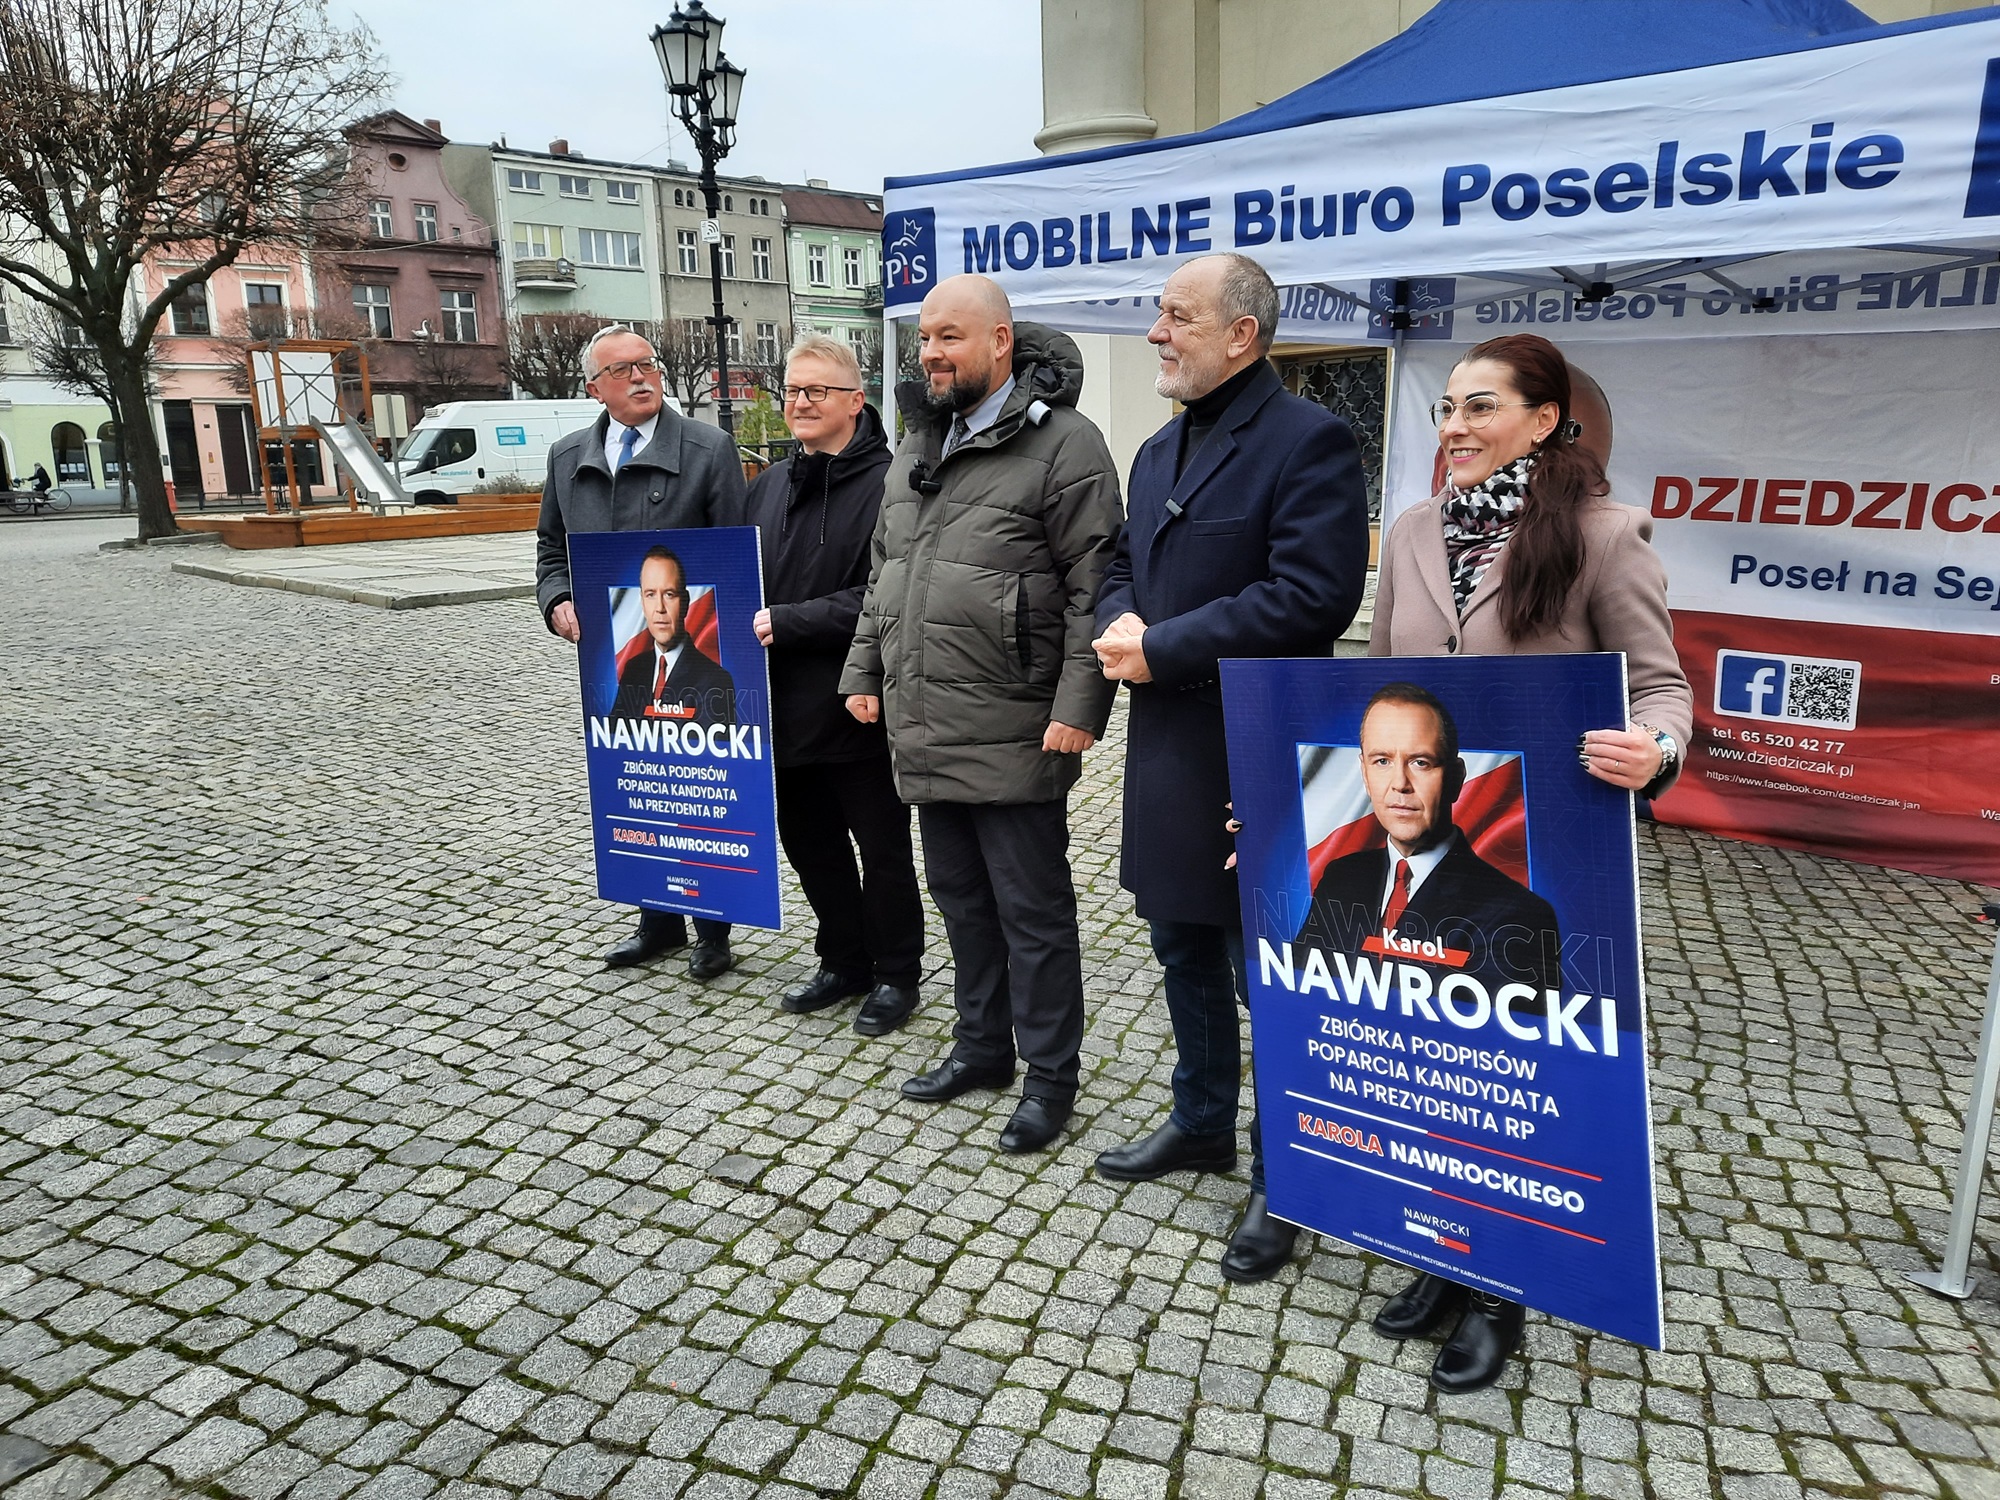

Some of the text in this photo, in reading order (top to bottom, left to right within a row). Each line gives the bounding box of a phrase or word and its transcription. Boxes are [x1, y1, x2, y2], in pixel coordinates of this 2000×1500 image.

[962, 121, 1905, 273] MOBILNE Biuro Poselskie
[885, 254, 928, 289] PiS
[1730, 554, 1852, 592] Poseł
[1863, 570, 1918, 597] na
[653, 698, 685, 715] Karol
[590, 715, 762, 761] NAWROCKI
[1712, 726, 1846, 755] tel. 65 520 42 77
[623, 759, 728, 782] ZBIÓRKA PODPISÓW
[1708, 746, 1854, 779] www.dziedziczak.pl
[617, 778, 738, 802] POPARCIA KANDYDATA
[628, 796, 728, 819] NA PREZYDENTA RP
[613, 827, 750, 858] KAROLA NAWROCKIEGO
[666, 875, 699, 887] NAWROCKI
[1382, 927, 1446, 959] Karol
[1258, 937, 1620, 1057] NAWROCKI
[1319, 1014, 1538, 1081] ZBIÓRKA PODPISÓW
[1308, 1038, 1560, 1118] POPARCIA KANDYDATA
[1329, 1071, 1536, 1141] NA PREZYDENTA RP
[1298, 1112, 1586, 1213] KAROLA NAWROCKIEGO
[1404, 1207, 1470, 1237] NAWROCKI
